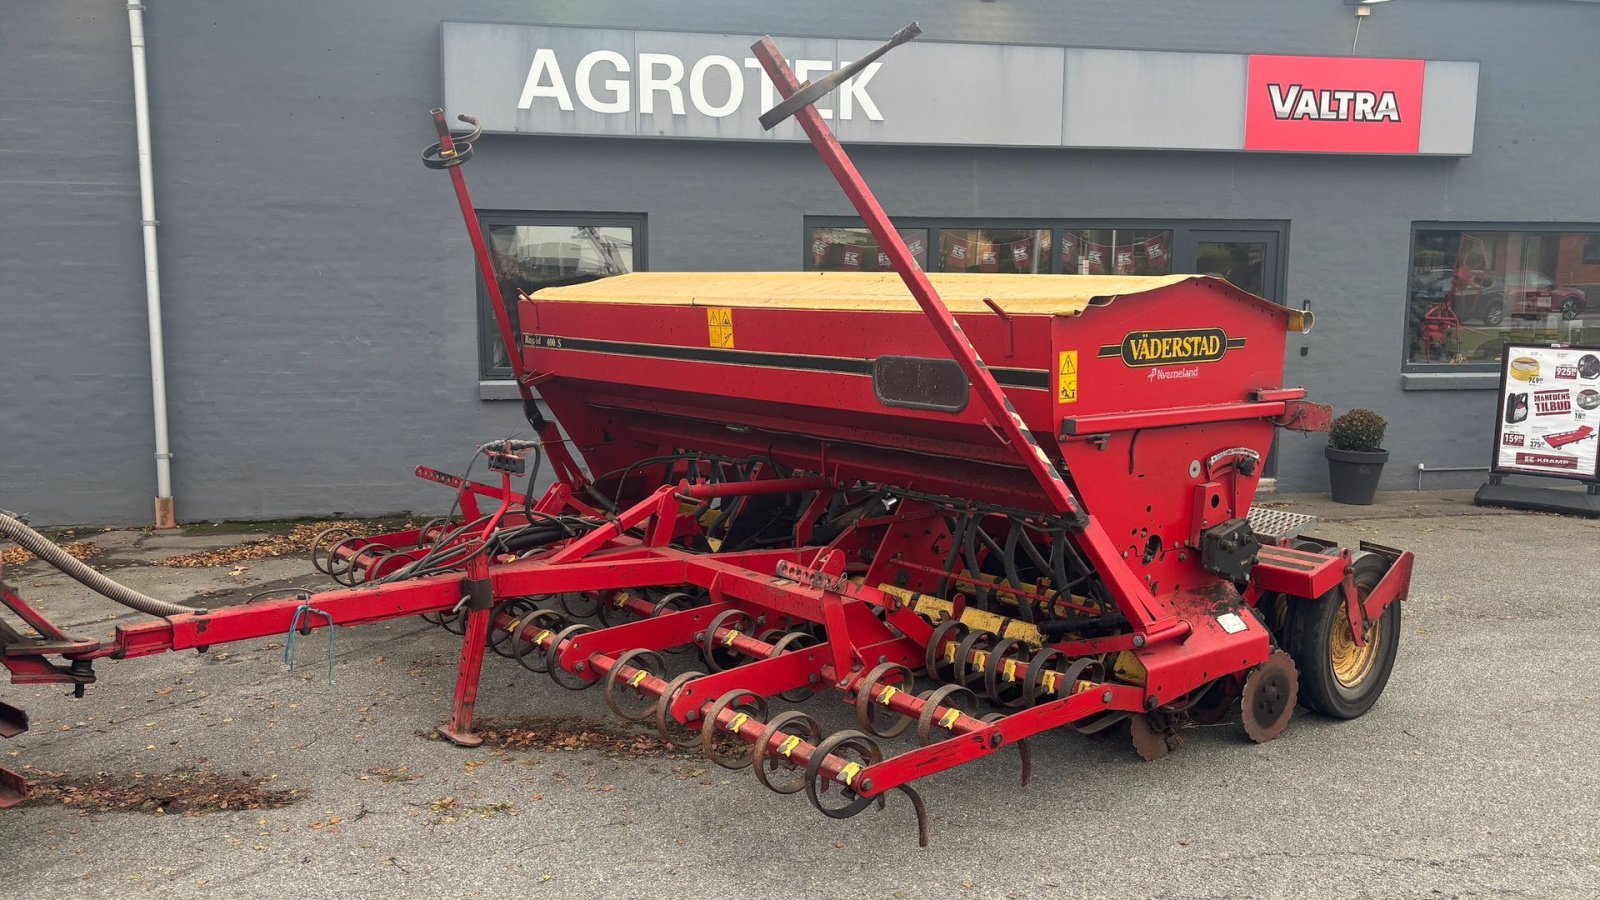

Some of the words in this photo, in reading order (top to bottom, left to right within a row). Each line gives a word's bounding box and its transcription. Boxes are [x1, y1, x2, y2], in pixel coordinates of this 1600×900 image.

[1267, 83, 1401, 122] VALTRA
[557, 338, 562, 348] S
[1129, 334, 1220, 360] VÄDERSTAD
[1535, 401, 1571, 412] TILBUD
